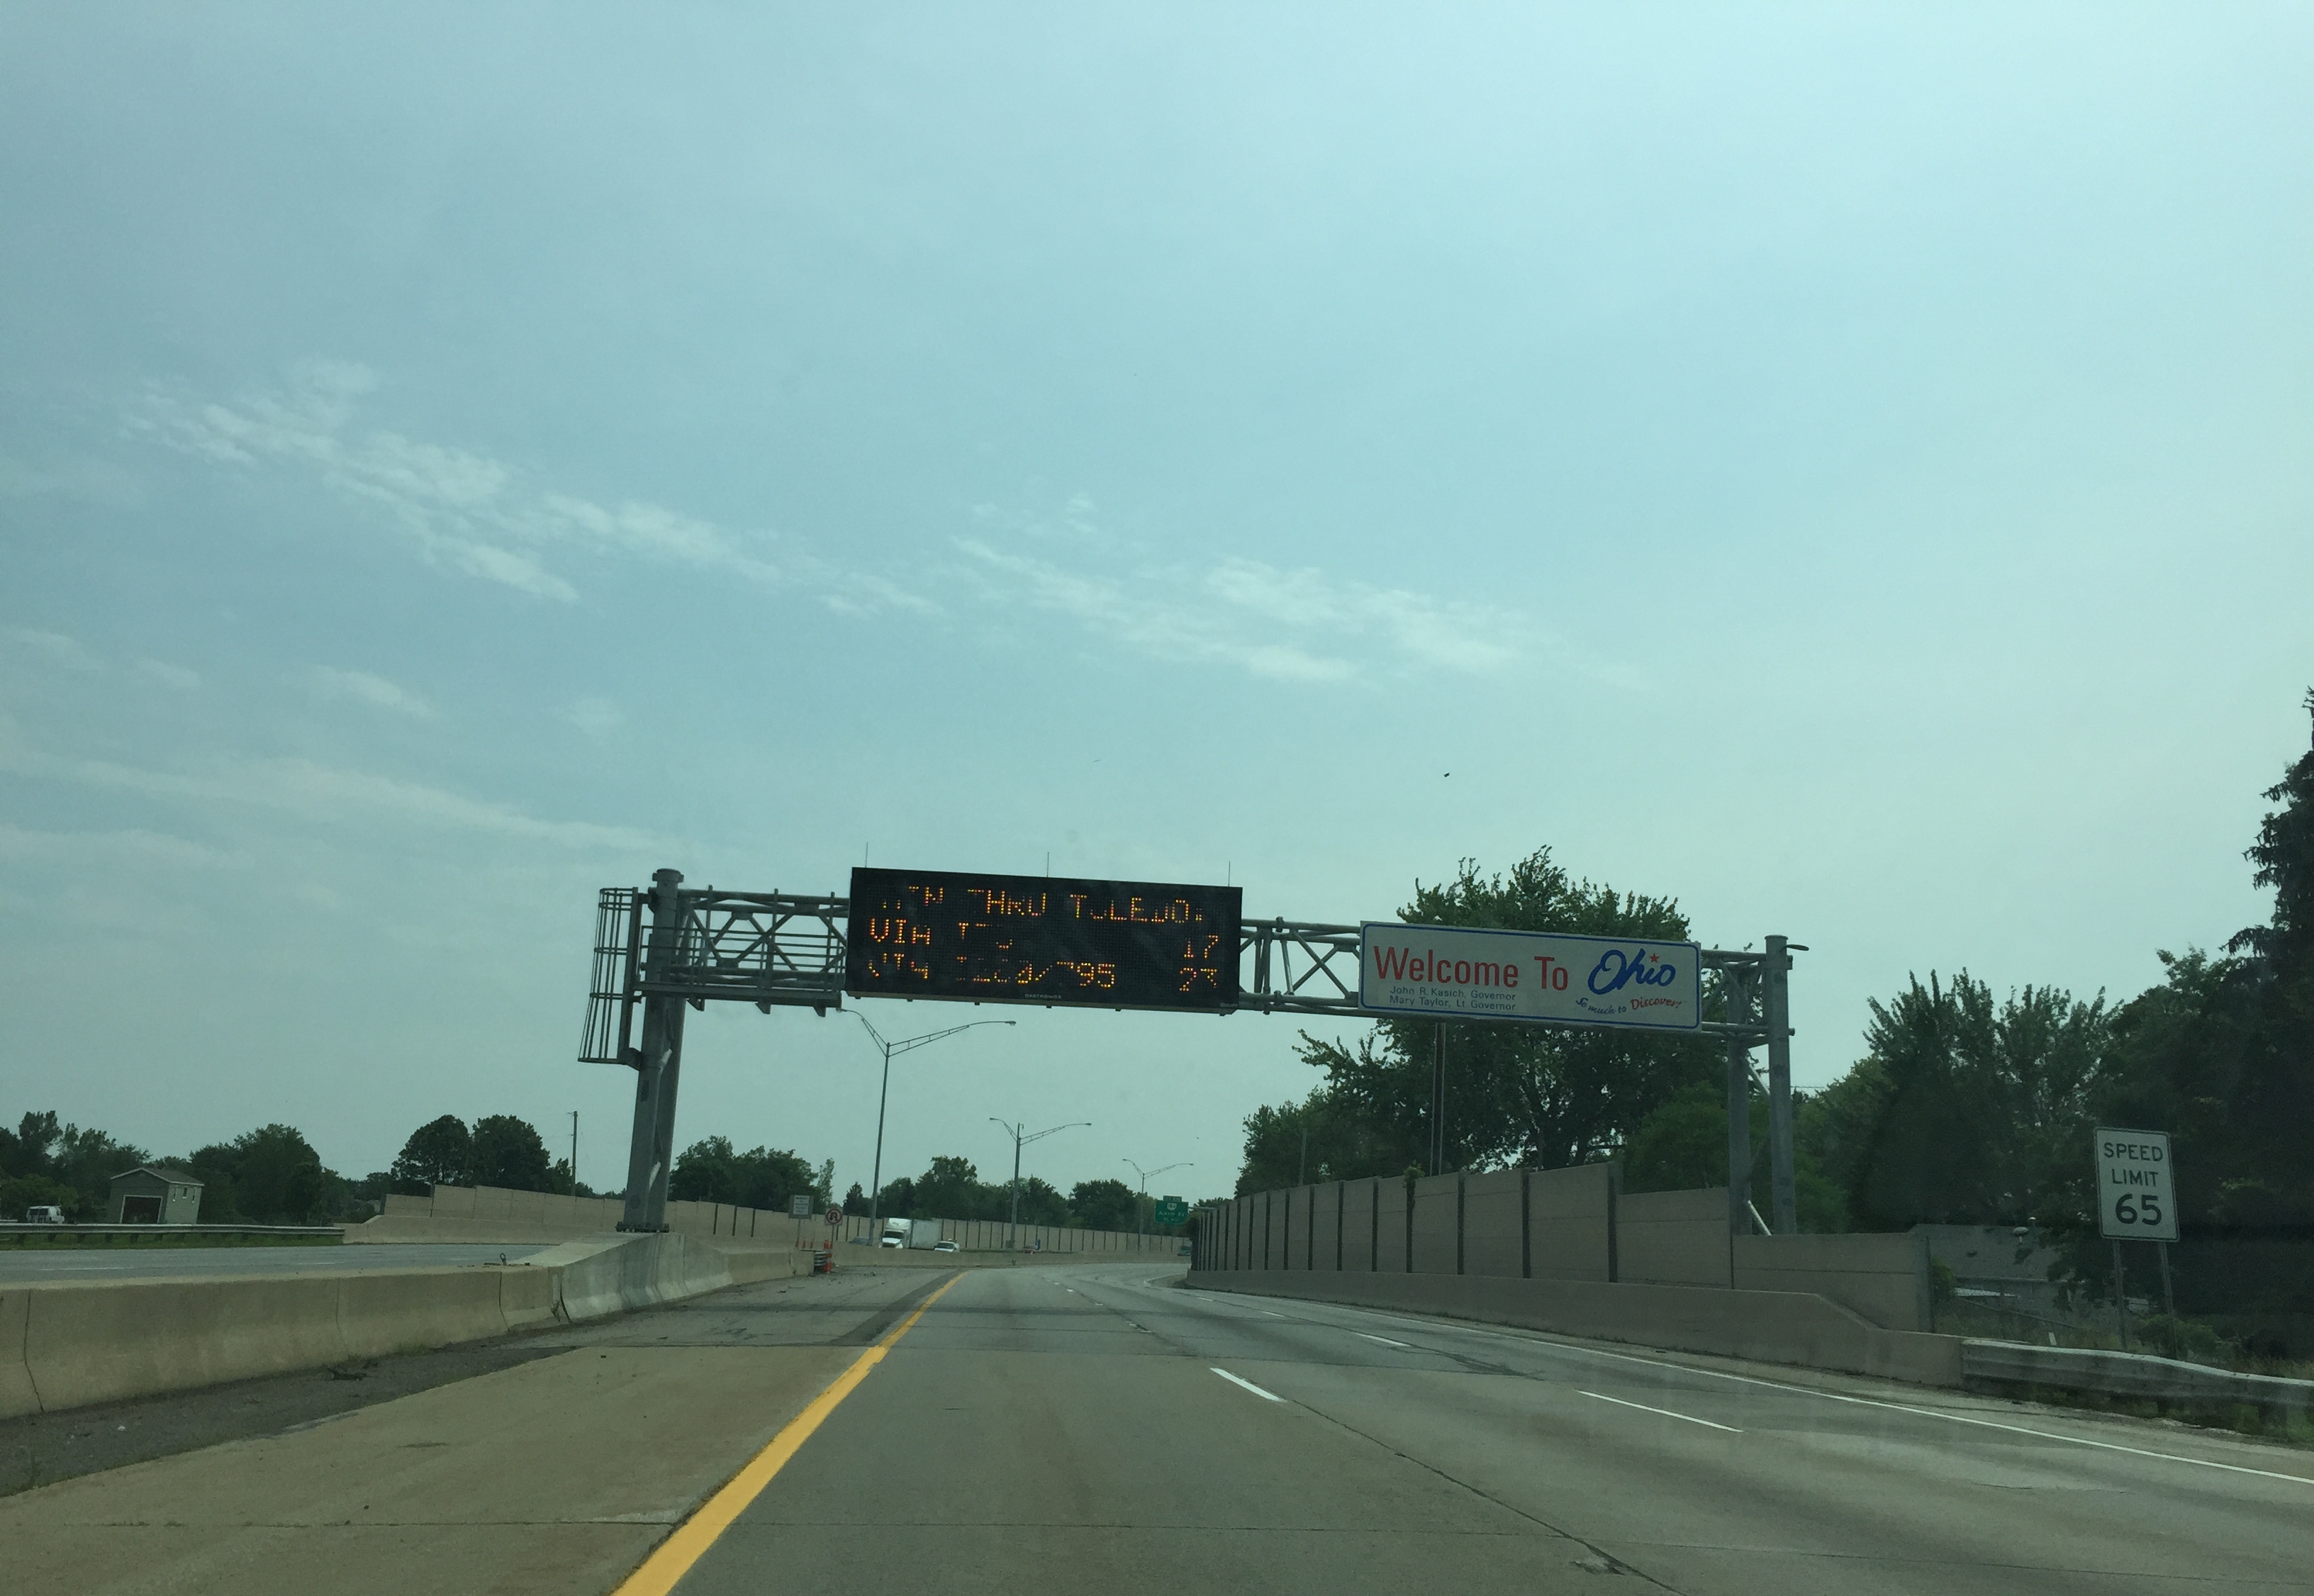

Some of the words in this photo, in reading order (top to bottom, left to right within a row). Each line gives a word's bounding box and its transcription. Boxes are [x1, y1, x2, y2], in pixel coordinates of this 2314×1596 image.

[870, 917, 932, 946] VIA
[1183, 933, 1219, 959] 17
[1373, 945, 1519, 988] Welcome
[1534, 955, 1569, 991] To
[1587, 947, 1677, 995] Ohio
[1390, 986, 1414, 995] John
[1419, 986, 1429, 995] R.
[1470, 990, 1516, 1001] Governor
[1390, 995, 1415, 1006] Mary
[1419, 996, 1451, 1008] Taylor,
[1470, 1000, 1516, 1010] Governor
[1575, 997, 1589, 1008] So
[1587, 1005, 1616, 1015] much
[1617, 1005, 1627, 1014] to
[2103, 1142, 2164, 1161] SPEED
[2111, 1168, 2159, 1188] LIMIT
[2115, 1193, 2162, 1226] 65
